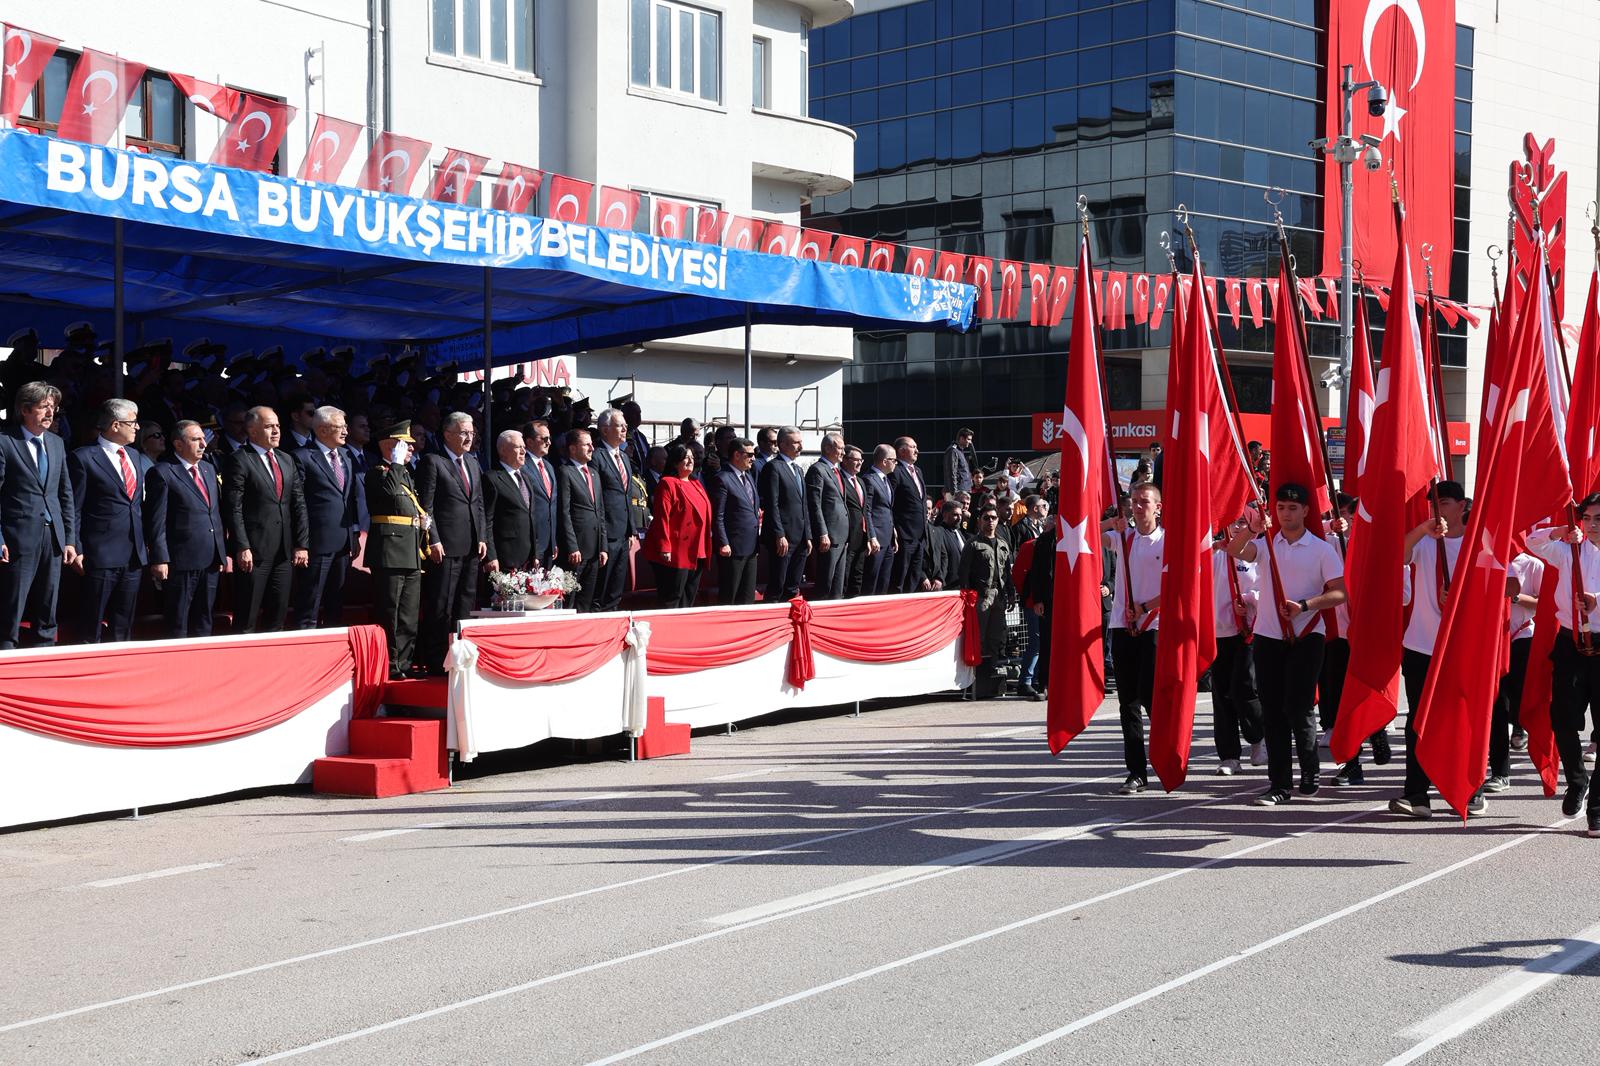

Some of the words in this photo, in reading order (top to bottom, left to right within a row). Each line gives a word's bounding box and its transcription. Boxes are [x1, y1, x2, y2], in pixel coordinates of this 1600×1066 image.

[46, 140, 239, 221] BURSA
[258, 179, 535, 256] BÜYÜKŞEHİR
[538, 218, 728, 290] BELEDİYESİ
